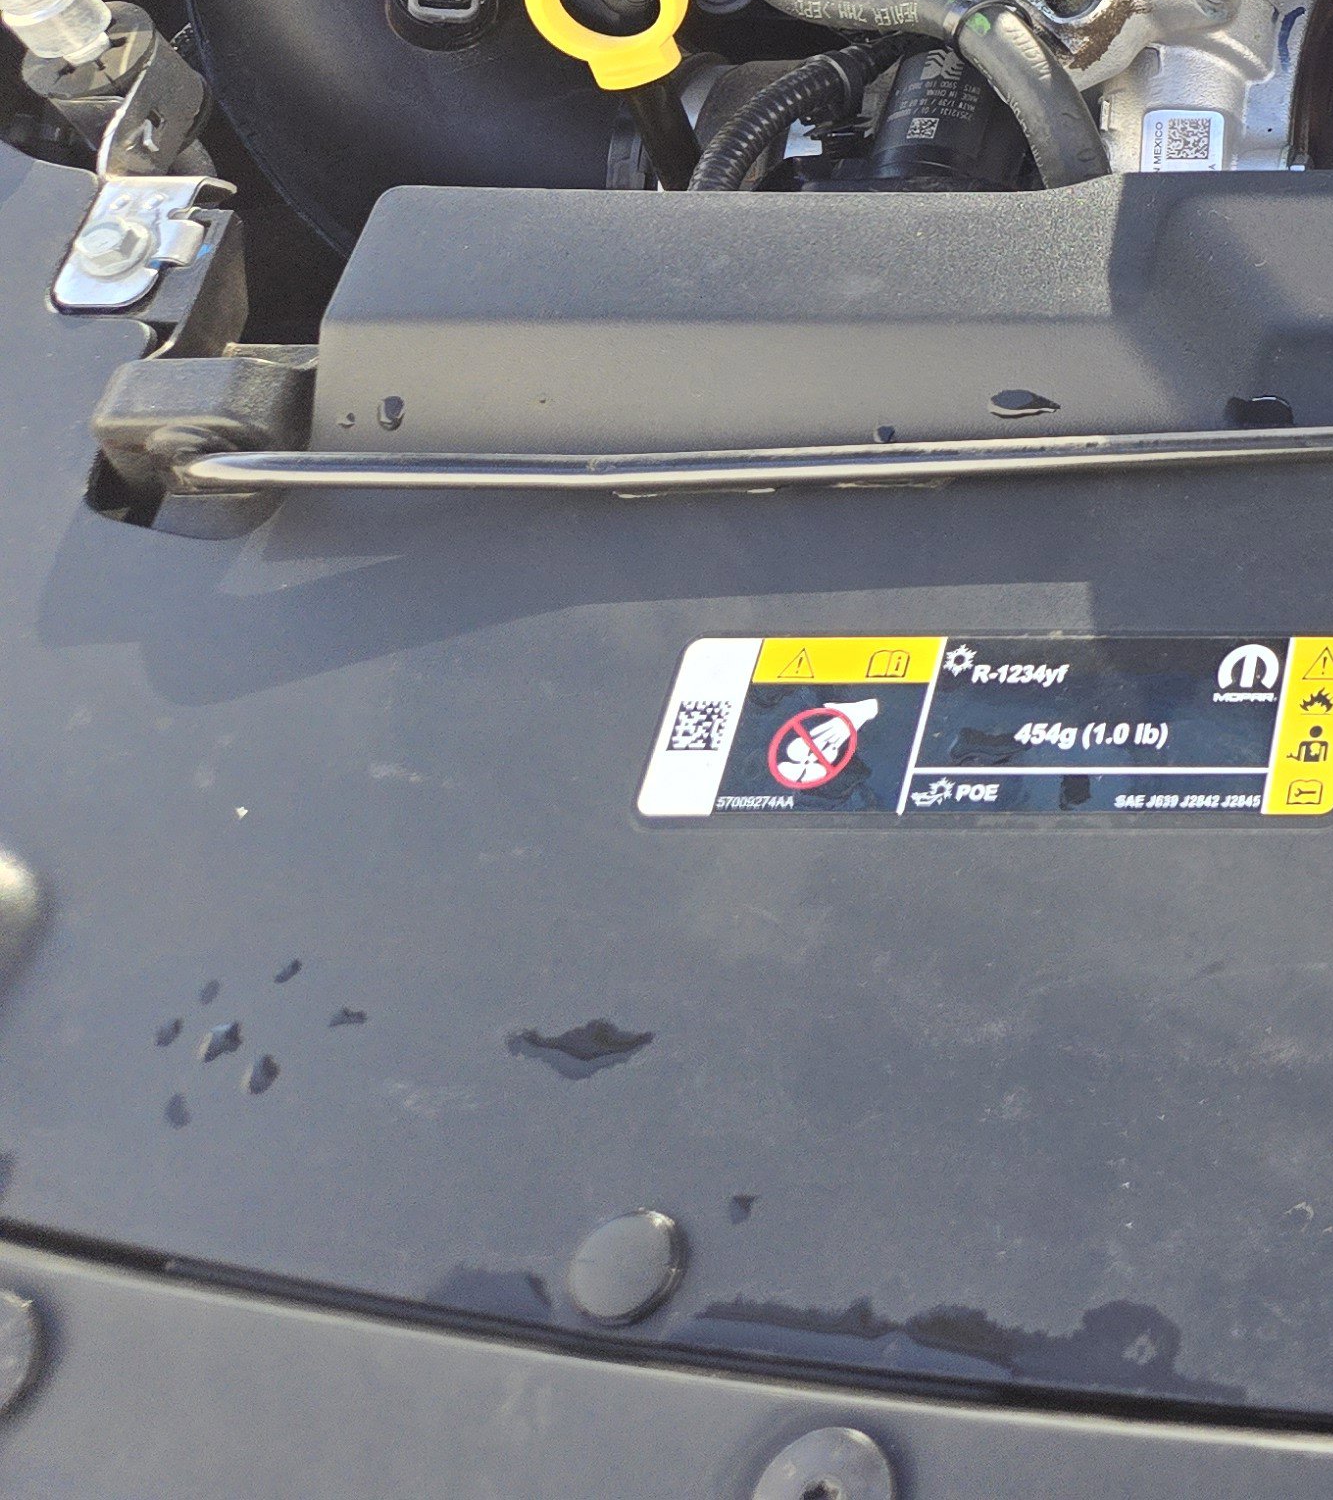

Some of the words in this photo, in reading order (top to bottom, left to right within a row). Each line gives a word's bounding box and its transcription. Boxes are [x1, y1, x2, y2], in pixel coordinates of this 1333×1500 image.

[1152, 121, 1163, 164] MEXICO
[971, 664, 1070, 688] R-1234yf
[1212, 692, 1275, 702] MOPAR
[1013, 722, 1077, 750] 454g
[1081, 722, 1131, 750] (1.0
[1134, 722, 1169, 750] lb)
[955, 783, 1000, 802] POE
[1113, 794, 1146, 808] SAE
[716, 795, 795, 810] 57009274AA
